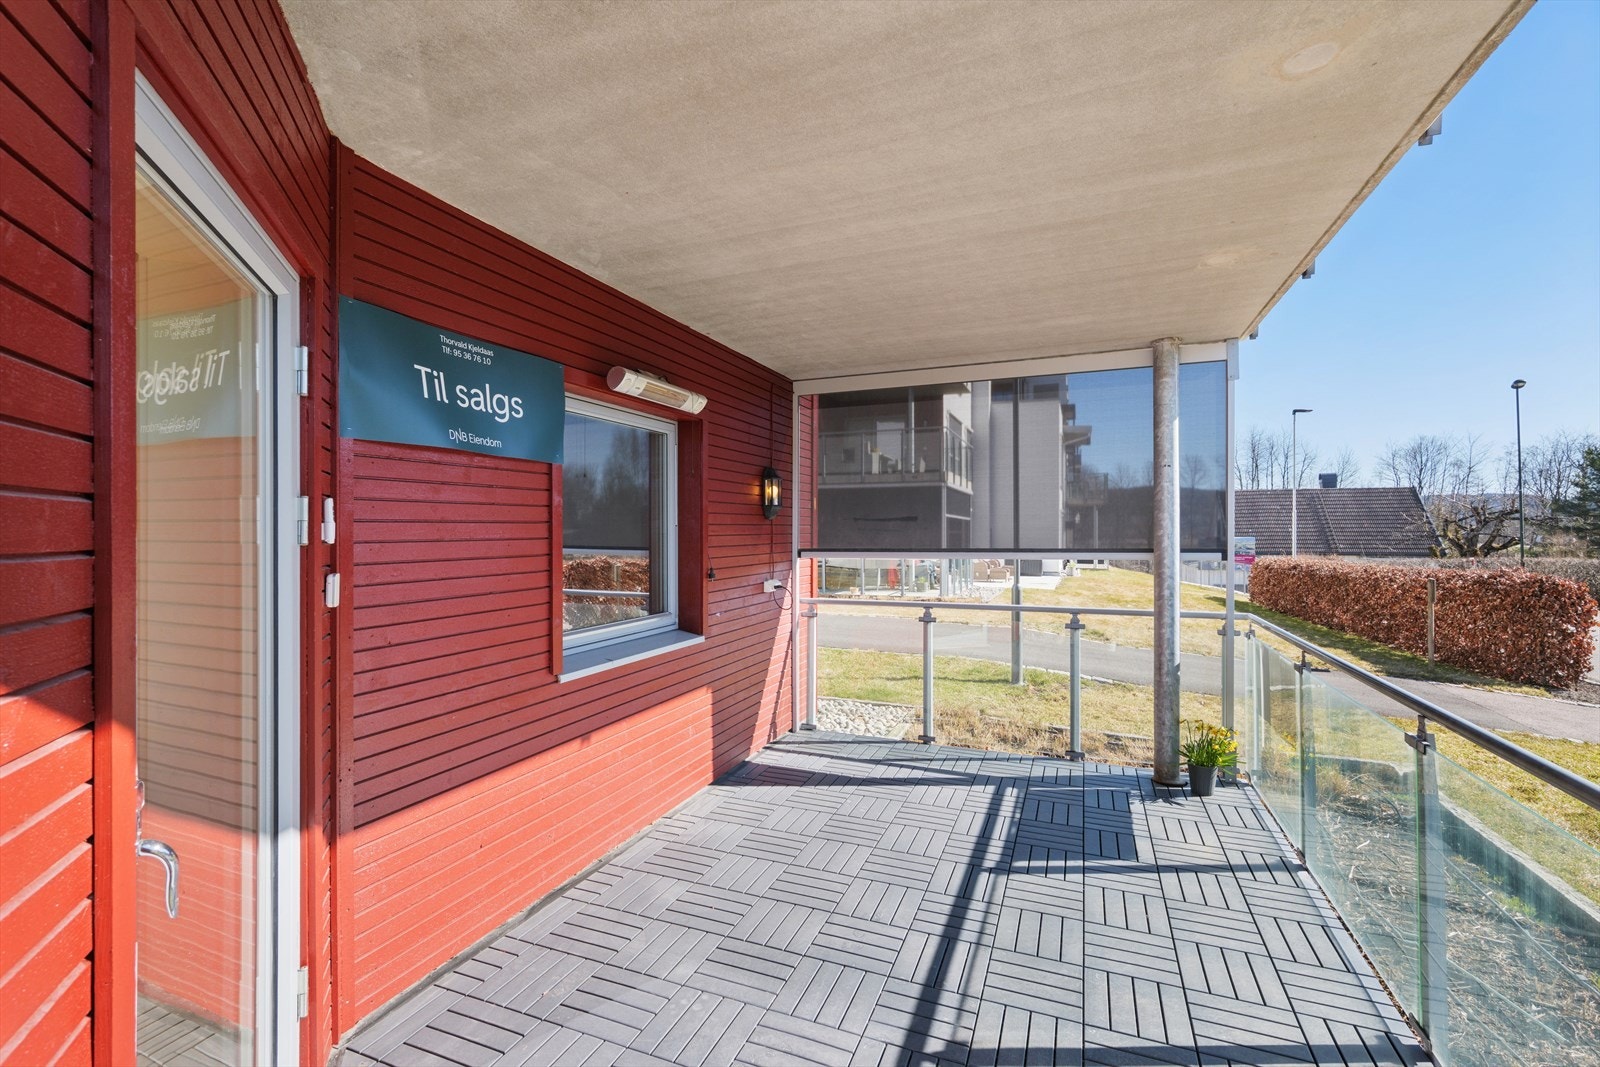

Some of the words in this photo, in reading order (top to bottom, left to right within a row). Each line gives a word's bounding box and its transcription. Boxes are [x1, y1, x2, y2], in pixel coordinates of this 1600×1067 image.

[440, 334, 467, 350] Thorvald
[468, 342, 494, 357] Kjeldaas
[453, 349, 462, 358] 95
[463, 351, 472, 361] 36
[473, 353, 482, 363] 76
[483, 356, 492, 366] 10
[414, 364, 449, 404] Til
[455, 383, 524, 423] salgs
[449, 427, 468, 444] DNB
[469, 434, 502, 448] Eiendom
